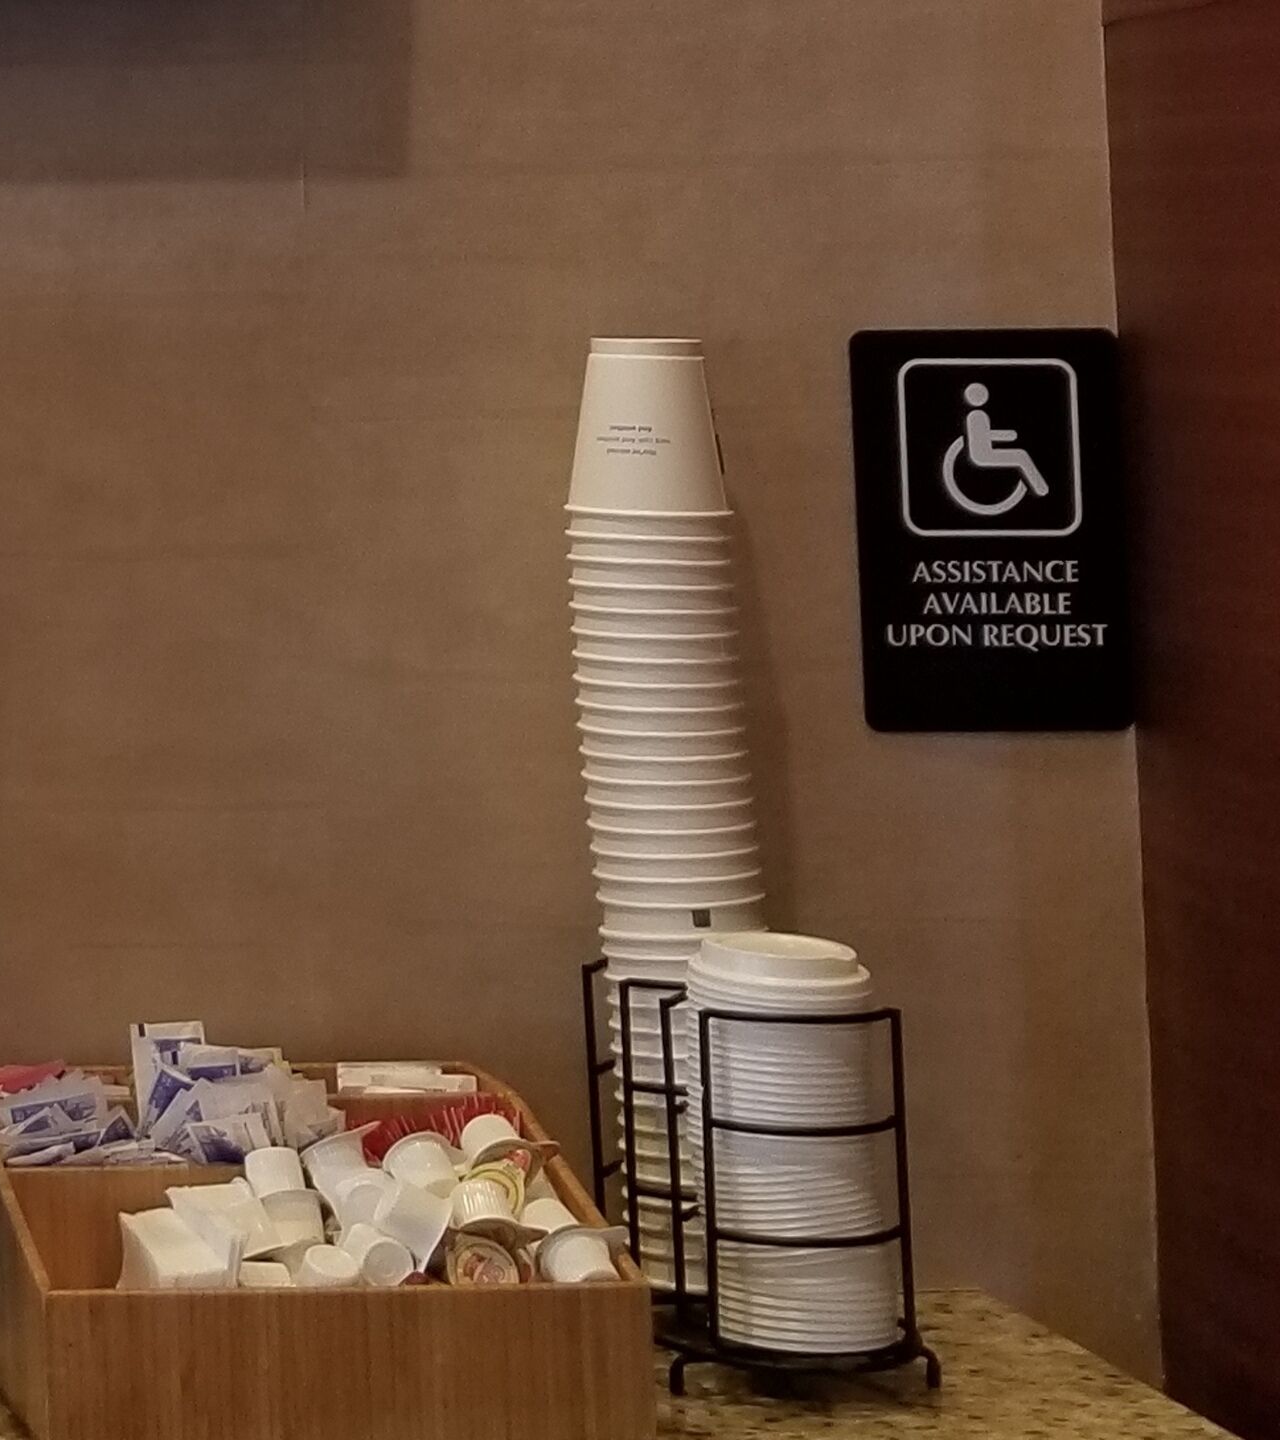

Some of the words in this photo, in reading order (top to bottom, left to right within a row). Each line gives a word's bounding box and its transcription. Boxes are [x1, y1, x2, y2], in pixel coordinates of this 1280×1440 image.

[912, 560, 1079, 583] ASSISTANCE
[923, 592, 1072, 615] AVAILABLE
[887, 623, 974, 647] UPON
[983, 623, 1108, 652] REQUEST
